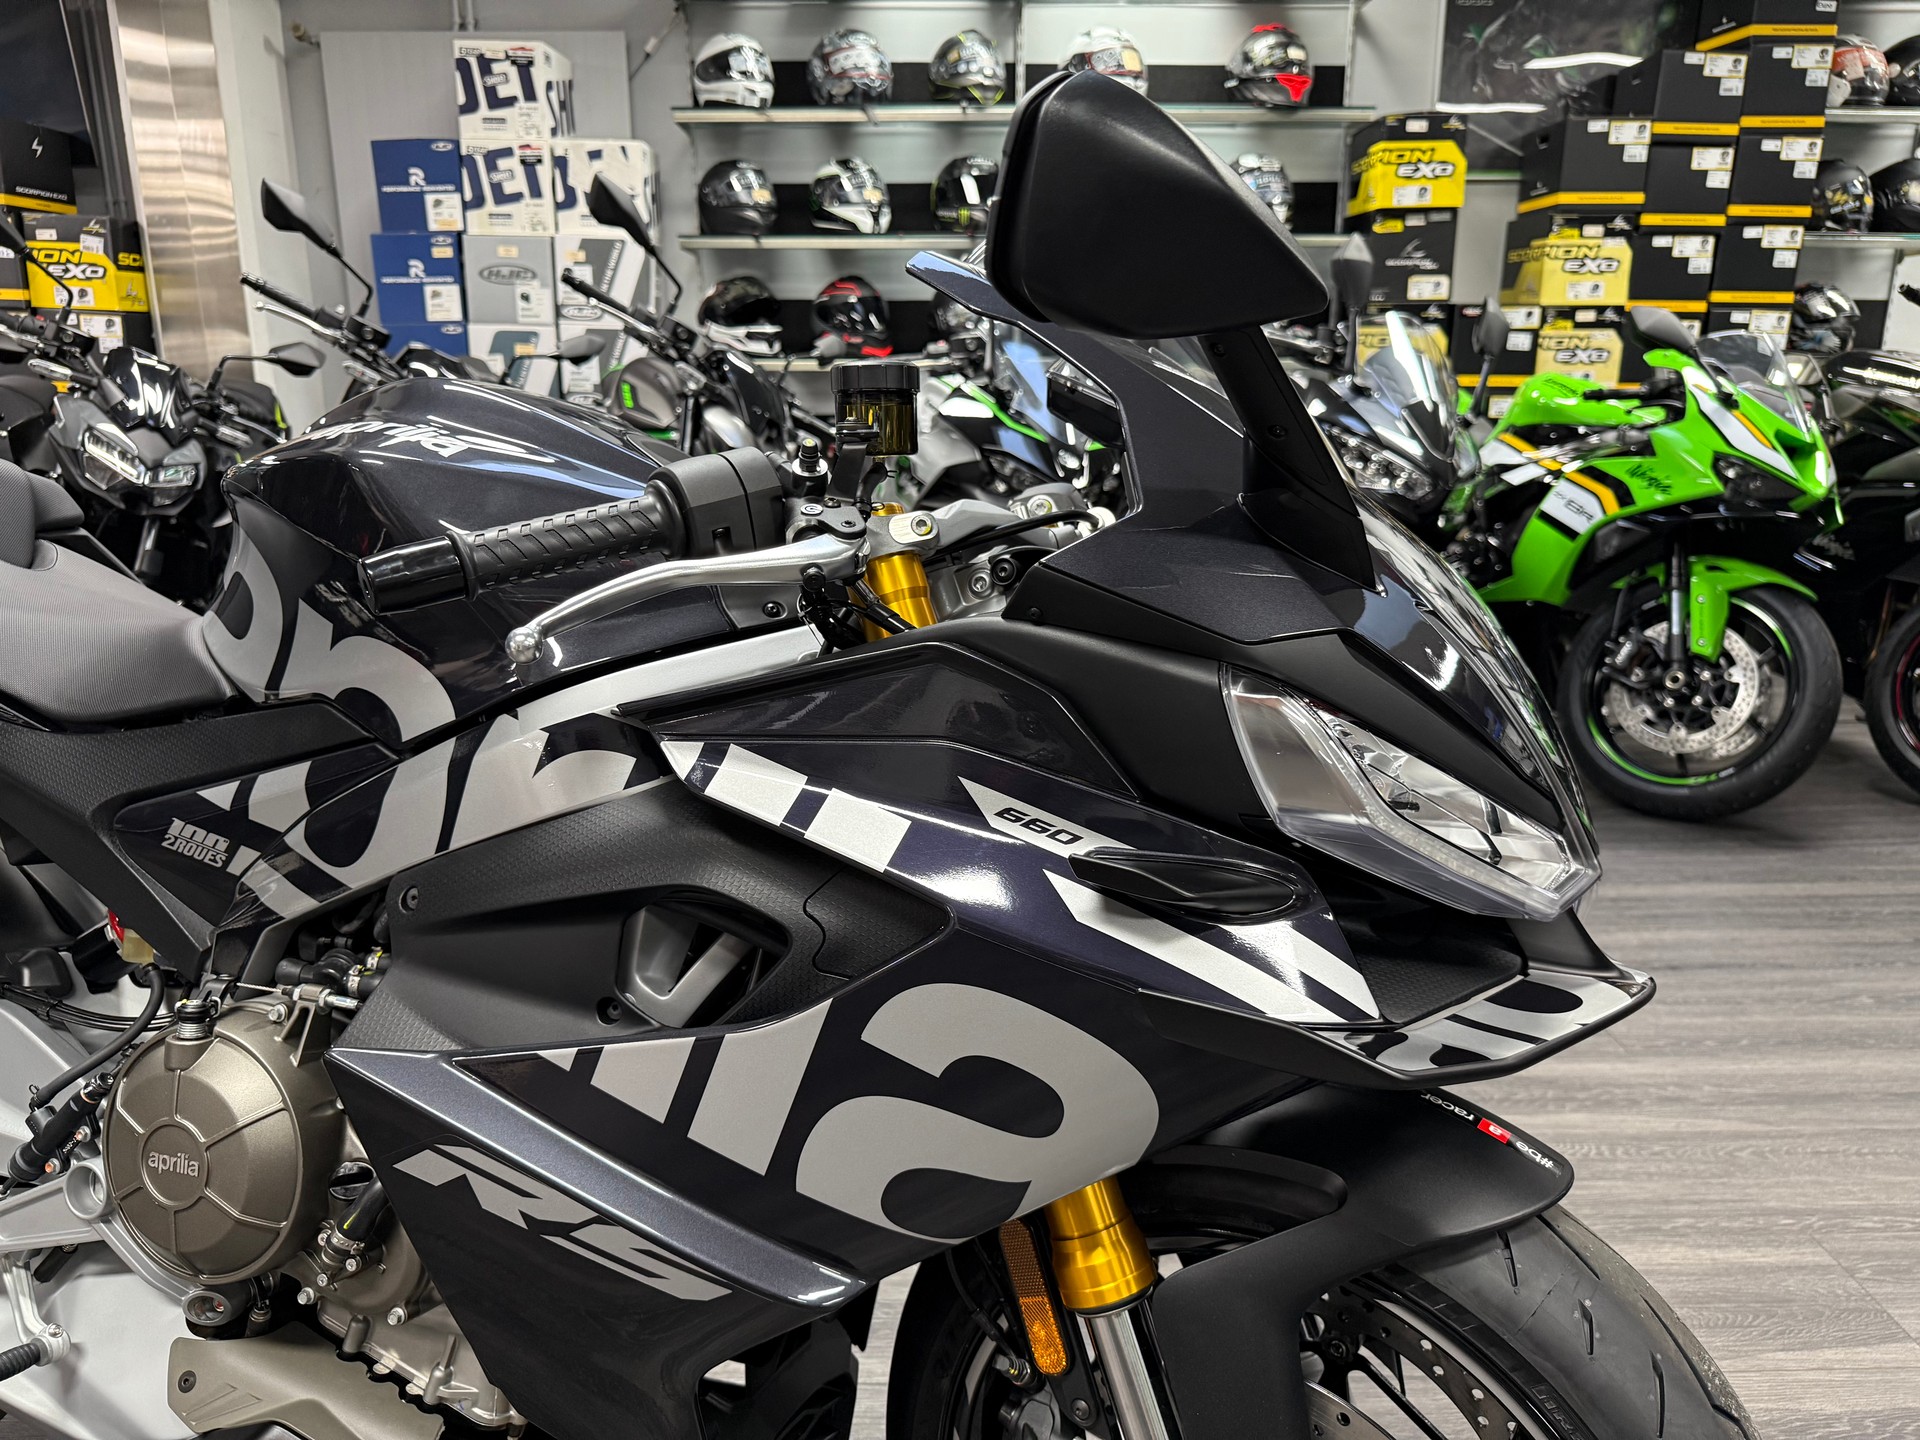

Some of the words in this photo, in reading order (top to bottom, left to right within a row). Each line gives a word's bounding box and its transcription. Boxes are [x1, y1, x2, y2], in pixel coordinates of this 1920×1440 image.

[1396, 162, 1455, 179] EXO
[48, 263, 105, 279] EXO
[1563, 258, 1619, 274] EXO
[1554, 349, 1611, 364] EXO
[993, 807, 1085, 835] 660
[161, 833, 227, 868] 2ROUES
[1421, 1092, 1476, 1122] racer
[147, 1151, 199, 1178] aprilia
[1515, 1140, 1554, 1169] #be
